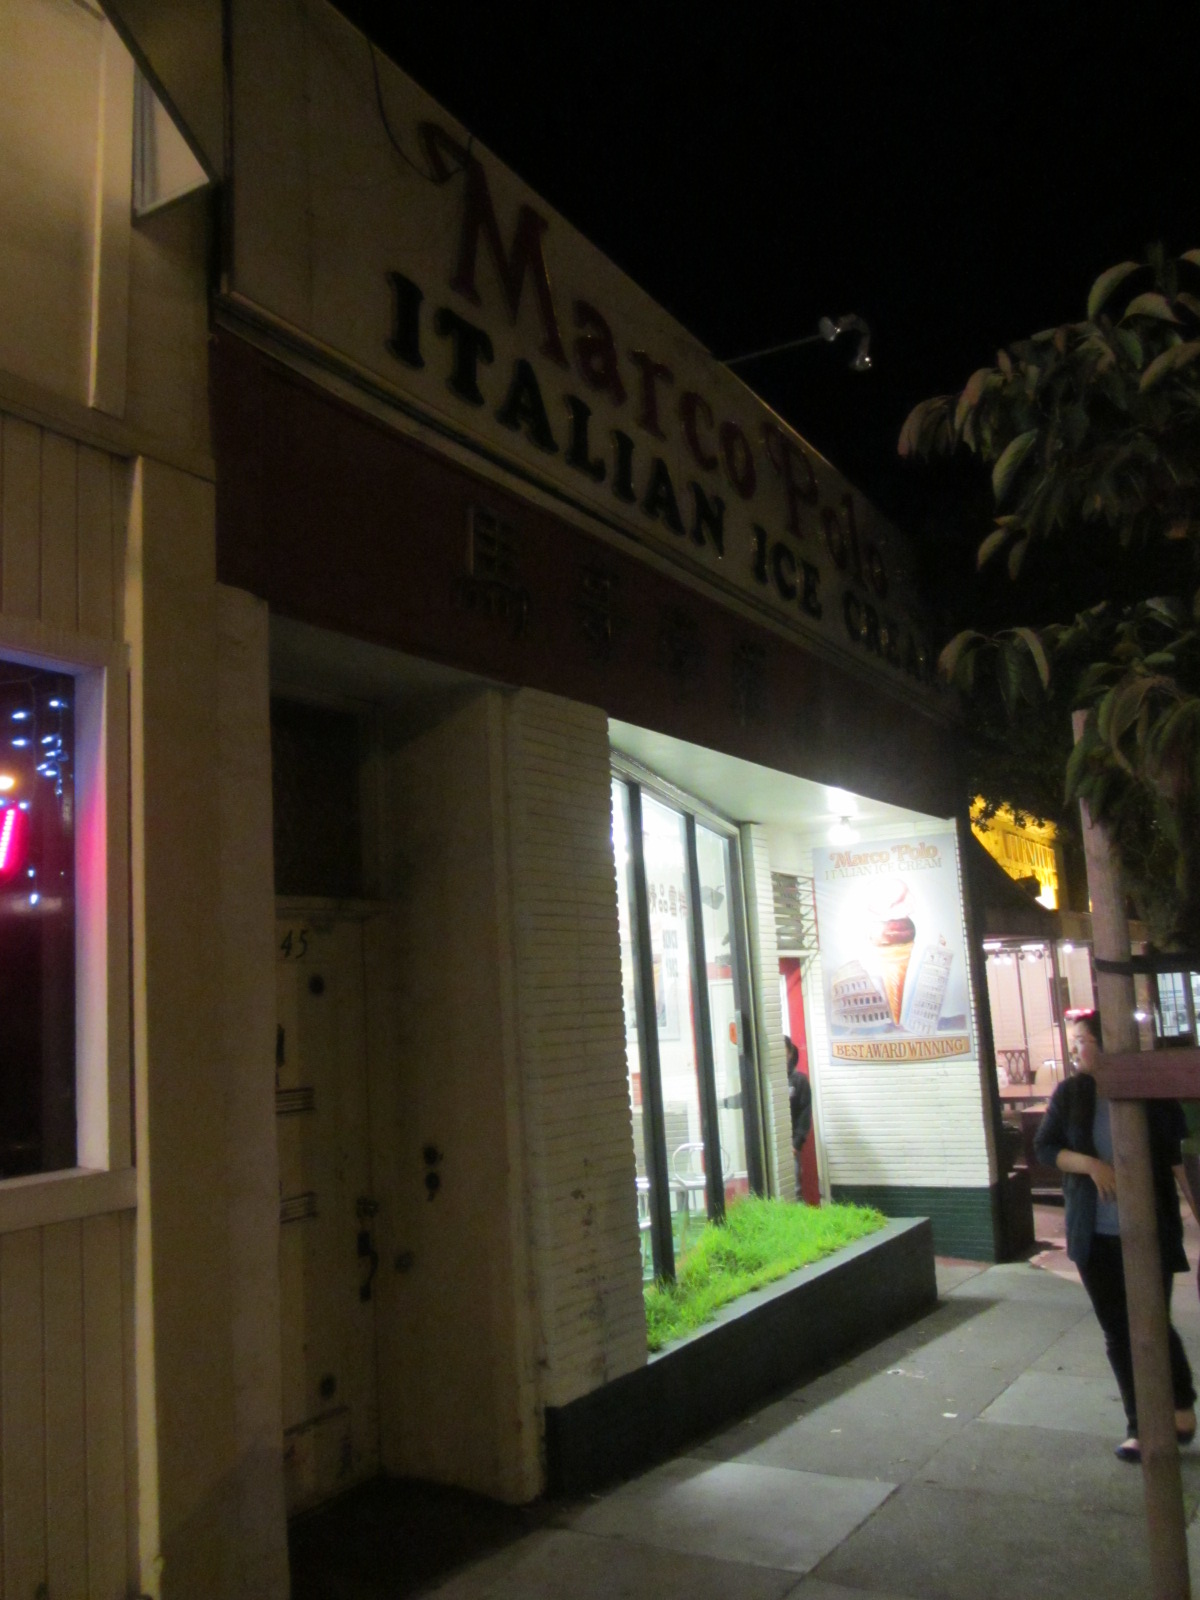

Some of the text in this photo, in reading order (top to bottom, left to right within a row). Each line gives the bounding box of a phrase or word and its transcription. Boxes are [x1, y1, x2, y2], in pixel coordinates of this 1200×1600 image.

[417, 120, 889, 600] Marco Polo
[384, 271, 727, 557] ITALIAN
[752, 524, 823, 620] ICE
[825, 858, 942, 880] ITALIAN ICE CREAM
[830, 842, 938, 869] Marco Polo
[836, 1039, 963, 1058] BEST AWARD WINNING
